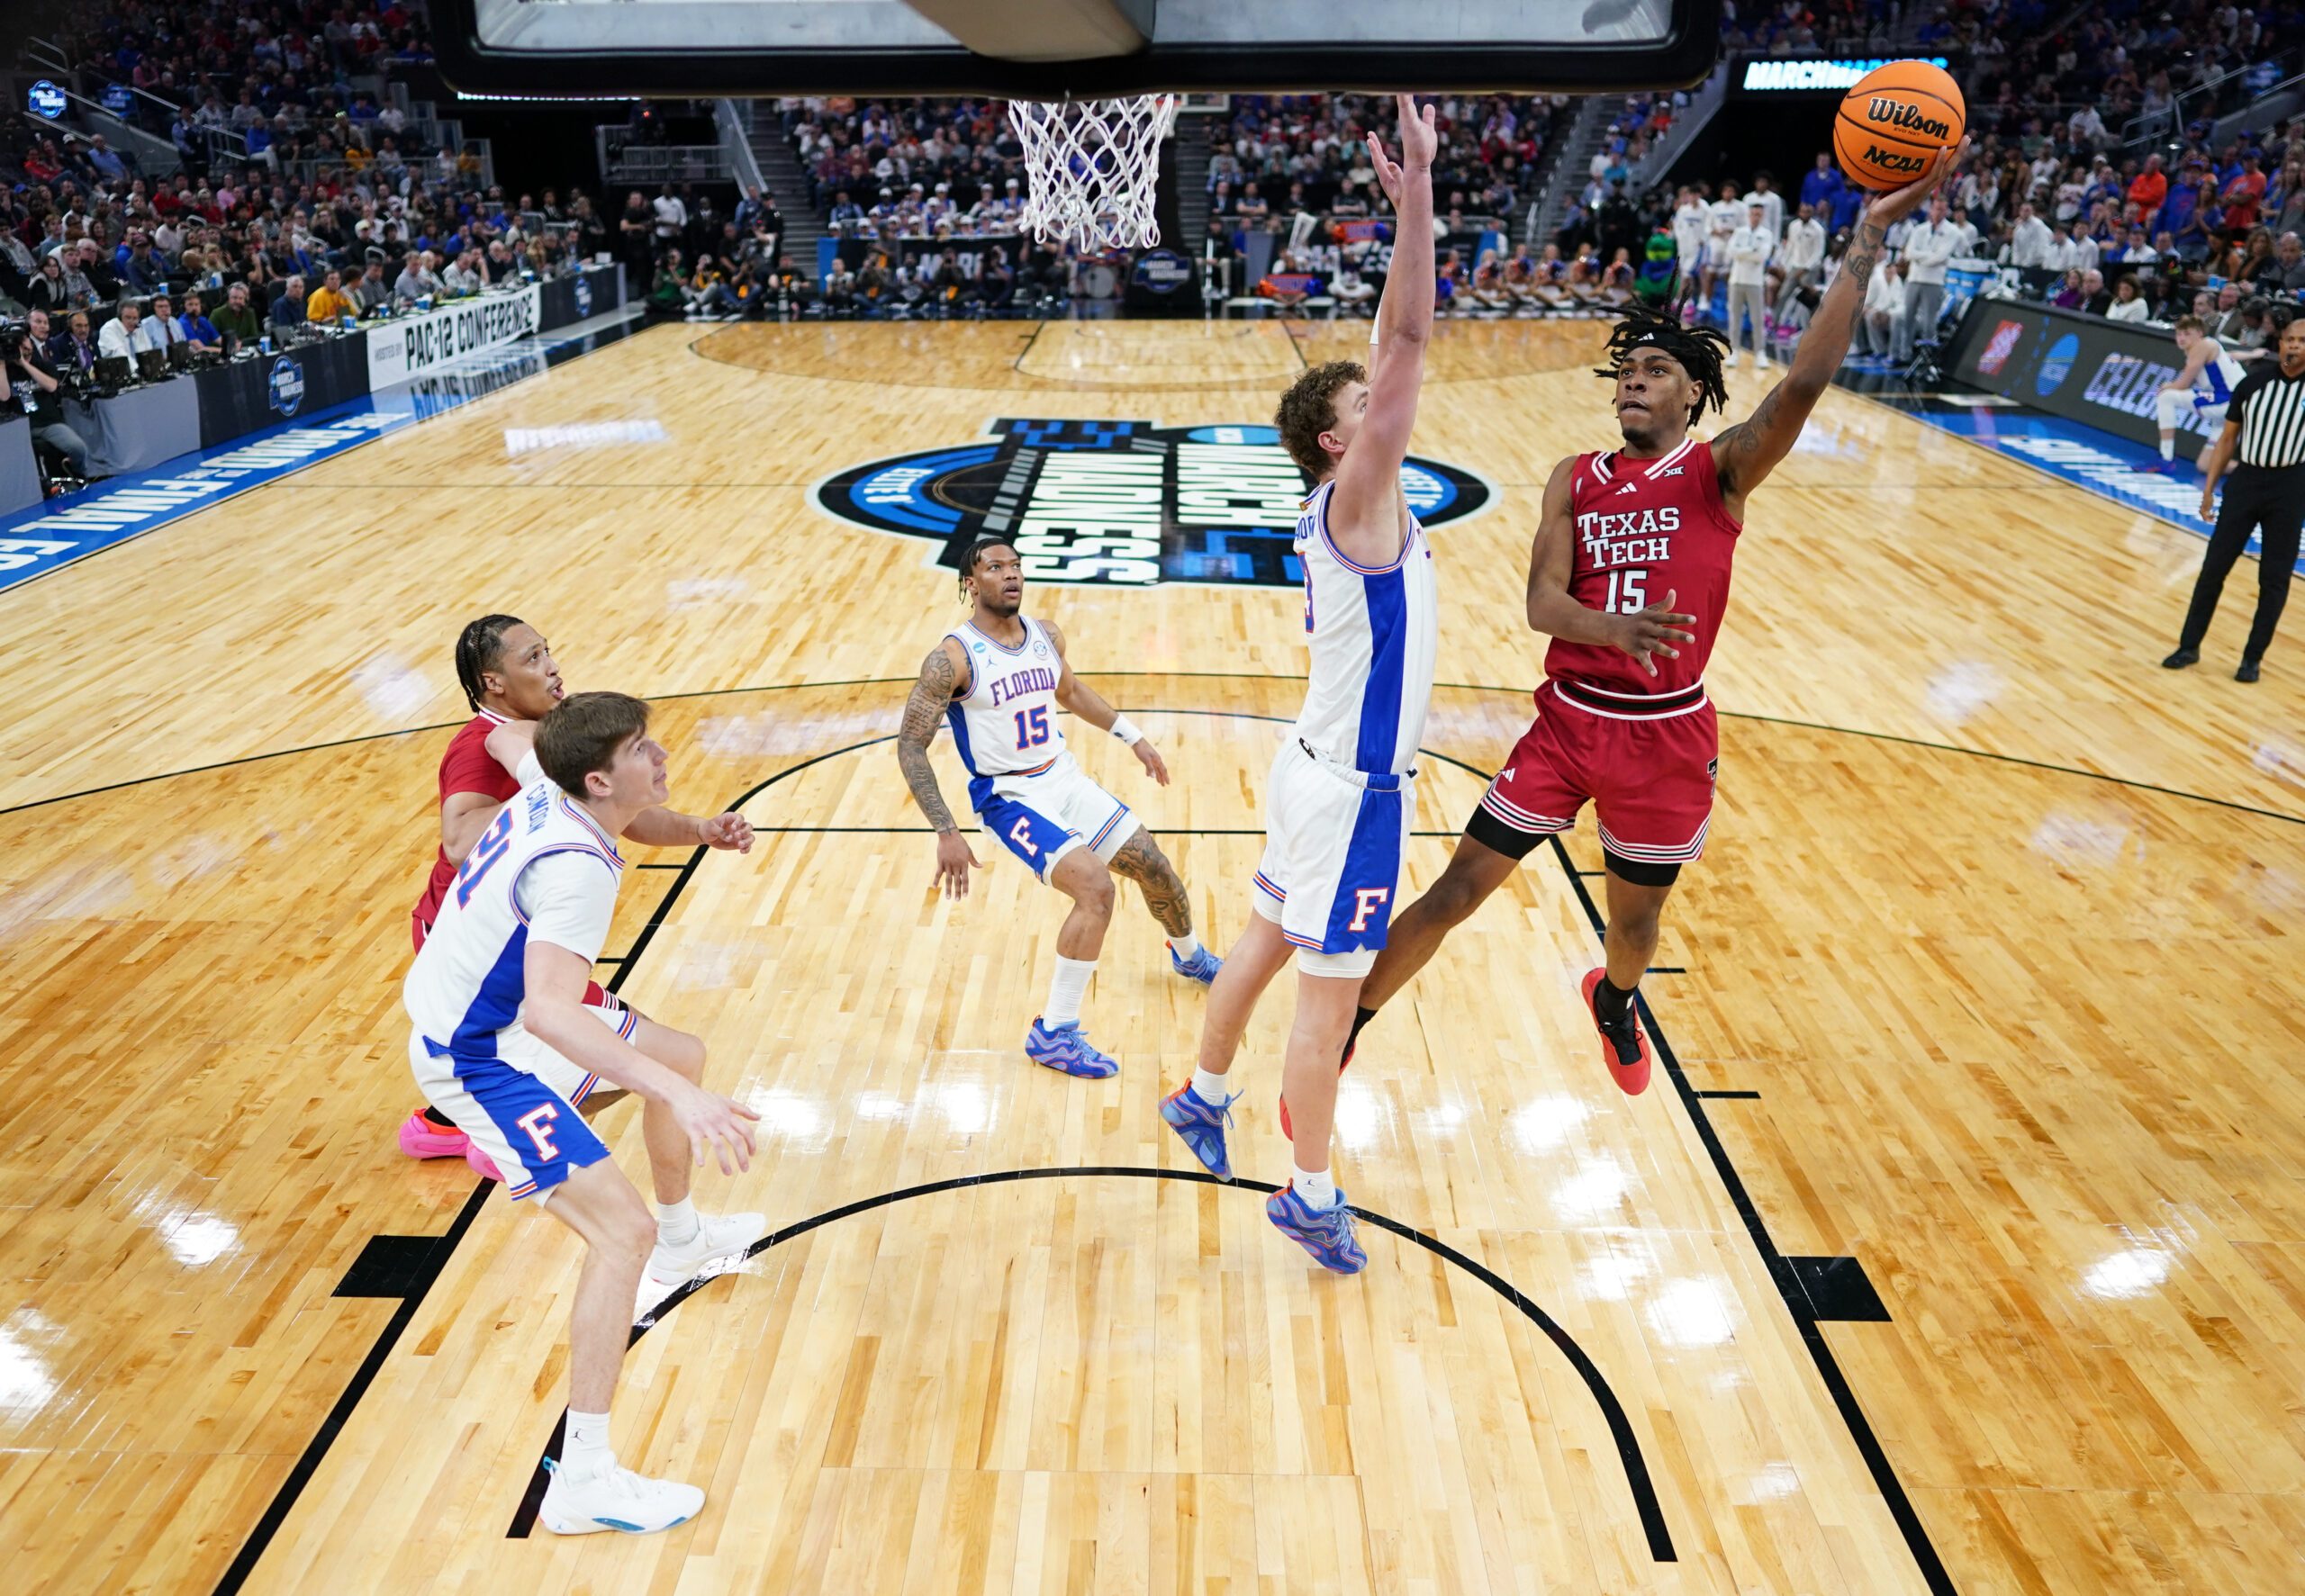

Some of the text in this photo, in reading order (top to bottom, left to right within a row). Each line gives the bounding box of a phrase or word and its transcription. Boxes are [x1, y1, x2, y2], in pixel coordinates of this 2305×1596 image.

[1867, 97, 1949, 140] Wilson
[1863, 145, 1926, 173] NCAA
[405, 293, 534, 372] PAC-12 CONFERENCE
[199, 429, 366, 468] ROAD
[8, 480, 234, 533] FINAL
[864, 467, 936, 504] ELITE 8
[1177, 443, 1307, 527] MARCH
[1017, 452, 1165, 582] MADNESS
[1604, 569, 1648, 615] 15
[990, 667, 1056, 707] FLORIDA
[1014, 704, 1050, 751] 15
[456, 807, 513, 911] 21
[1009, 816, 1039, 857] F
[1349, 887, 1388, 932] F
[516, 1101, 562, 1163] F
